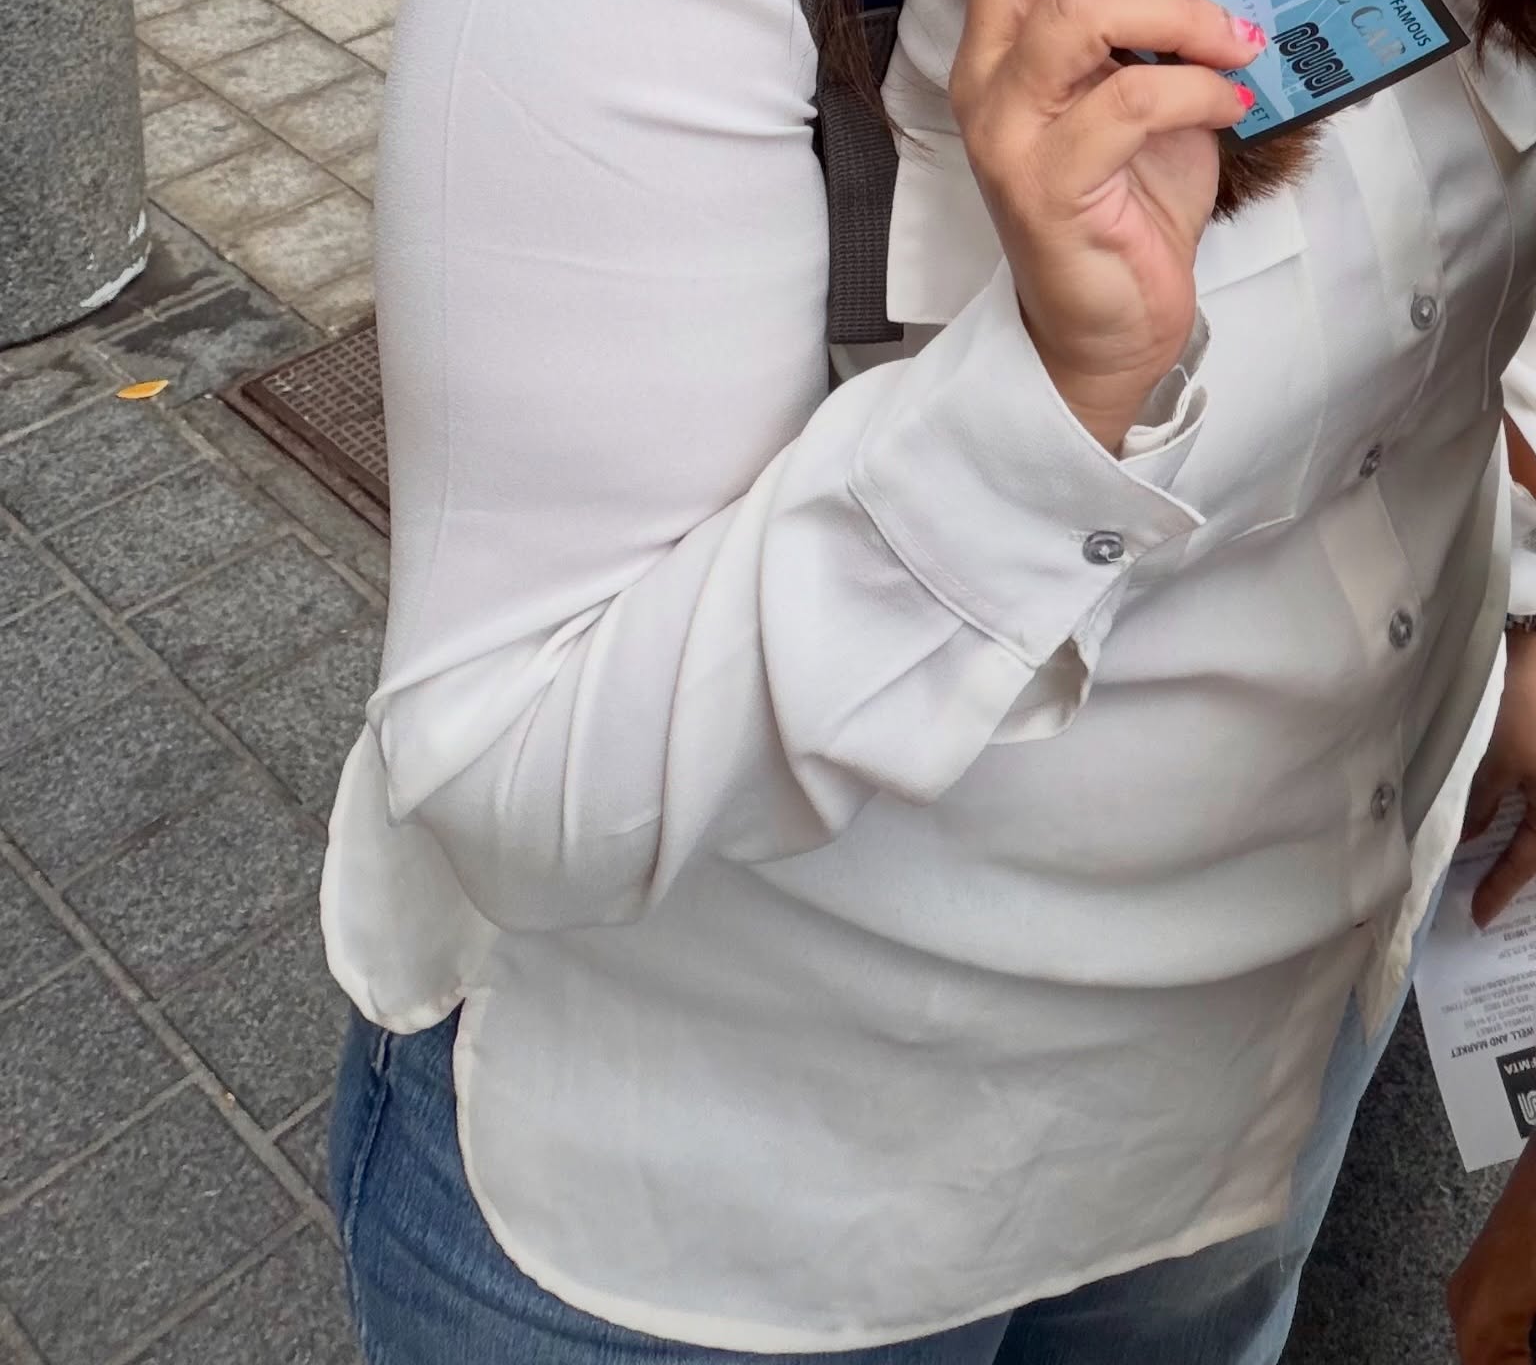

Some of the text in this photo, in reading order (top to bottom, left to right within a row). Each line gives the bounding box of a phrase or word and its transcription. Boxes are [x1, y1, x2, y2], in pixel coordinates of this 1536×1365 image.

[1510, 1026, 1534, 1041] WELL
[1450, 1039, 1488, 1059] MARKET
[1503, 1056, 1536, 1076] FMTA
